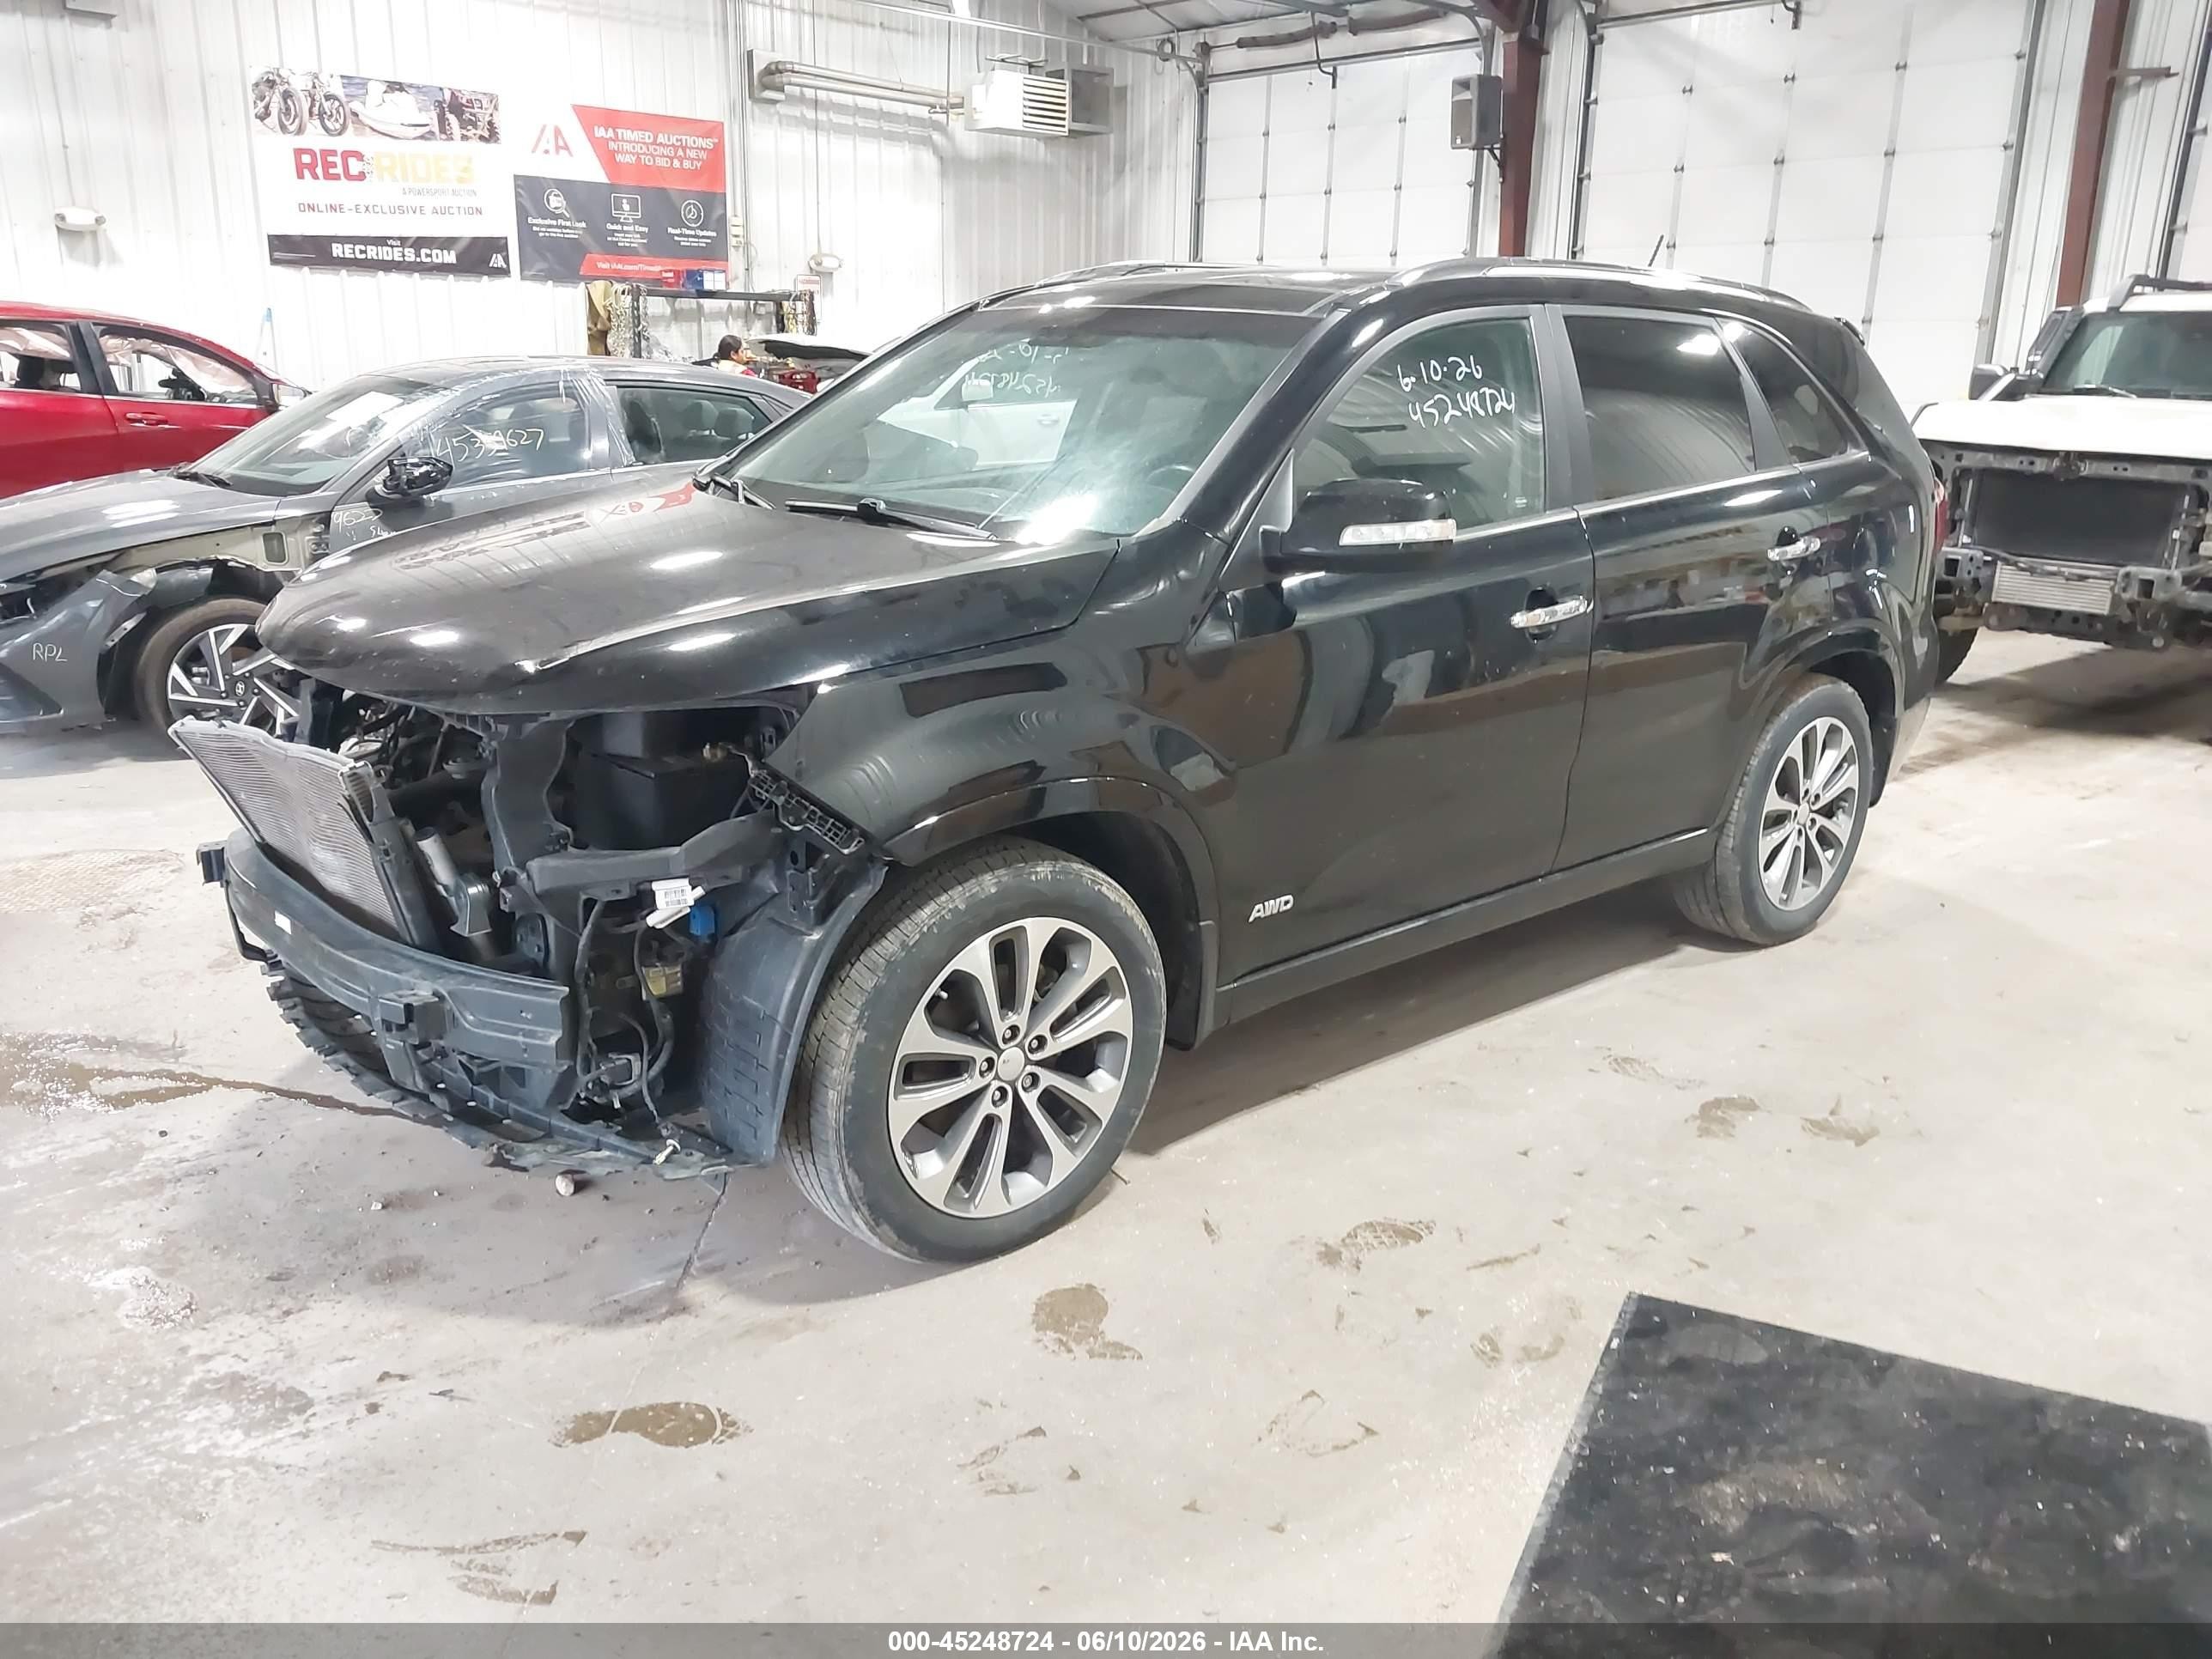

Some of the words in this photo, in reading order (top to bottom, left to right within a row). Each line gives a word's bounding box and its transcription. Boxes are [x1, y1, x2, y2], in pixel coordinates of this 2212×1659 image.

[593, 125, 615, 139] IAA
[615, 129, 654, 143] TIMED
[608, 141, 675, 157] INTRODUCING
[676, 148, 684, 157] A
[686, 149, 708, 160] NEW
[293, 148, 368, 181] REC
[614, 153, 637, 164] WAY
[639, 155, 653, 165] TO
[655, 157, 671, 167] BID
[672, 159, 681, 168] &
[683, 160, 702, 170] BUY
[298, 203, 426, 216] ONLINE-EXCLUSIVE
[431, 205, 483, 216] AUCTION
[527, 216, 557, 226] Exclusive
[557, 218, 572, 227] First
[605, 222, 623, 231] Quick
[635, 224, 649, 234] Easy
[667, 227, 696, 235] Real-Time
[696, 228, 717, 237] Updates
[331, 242, 457, 264] RECRIDES.COM
[1408, 387, 1516, 428] 45248724
[33, 642, 69, 662] RPL
[1248, 894, 1294, 923] AWD
